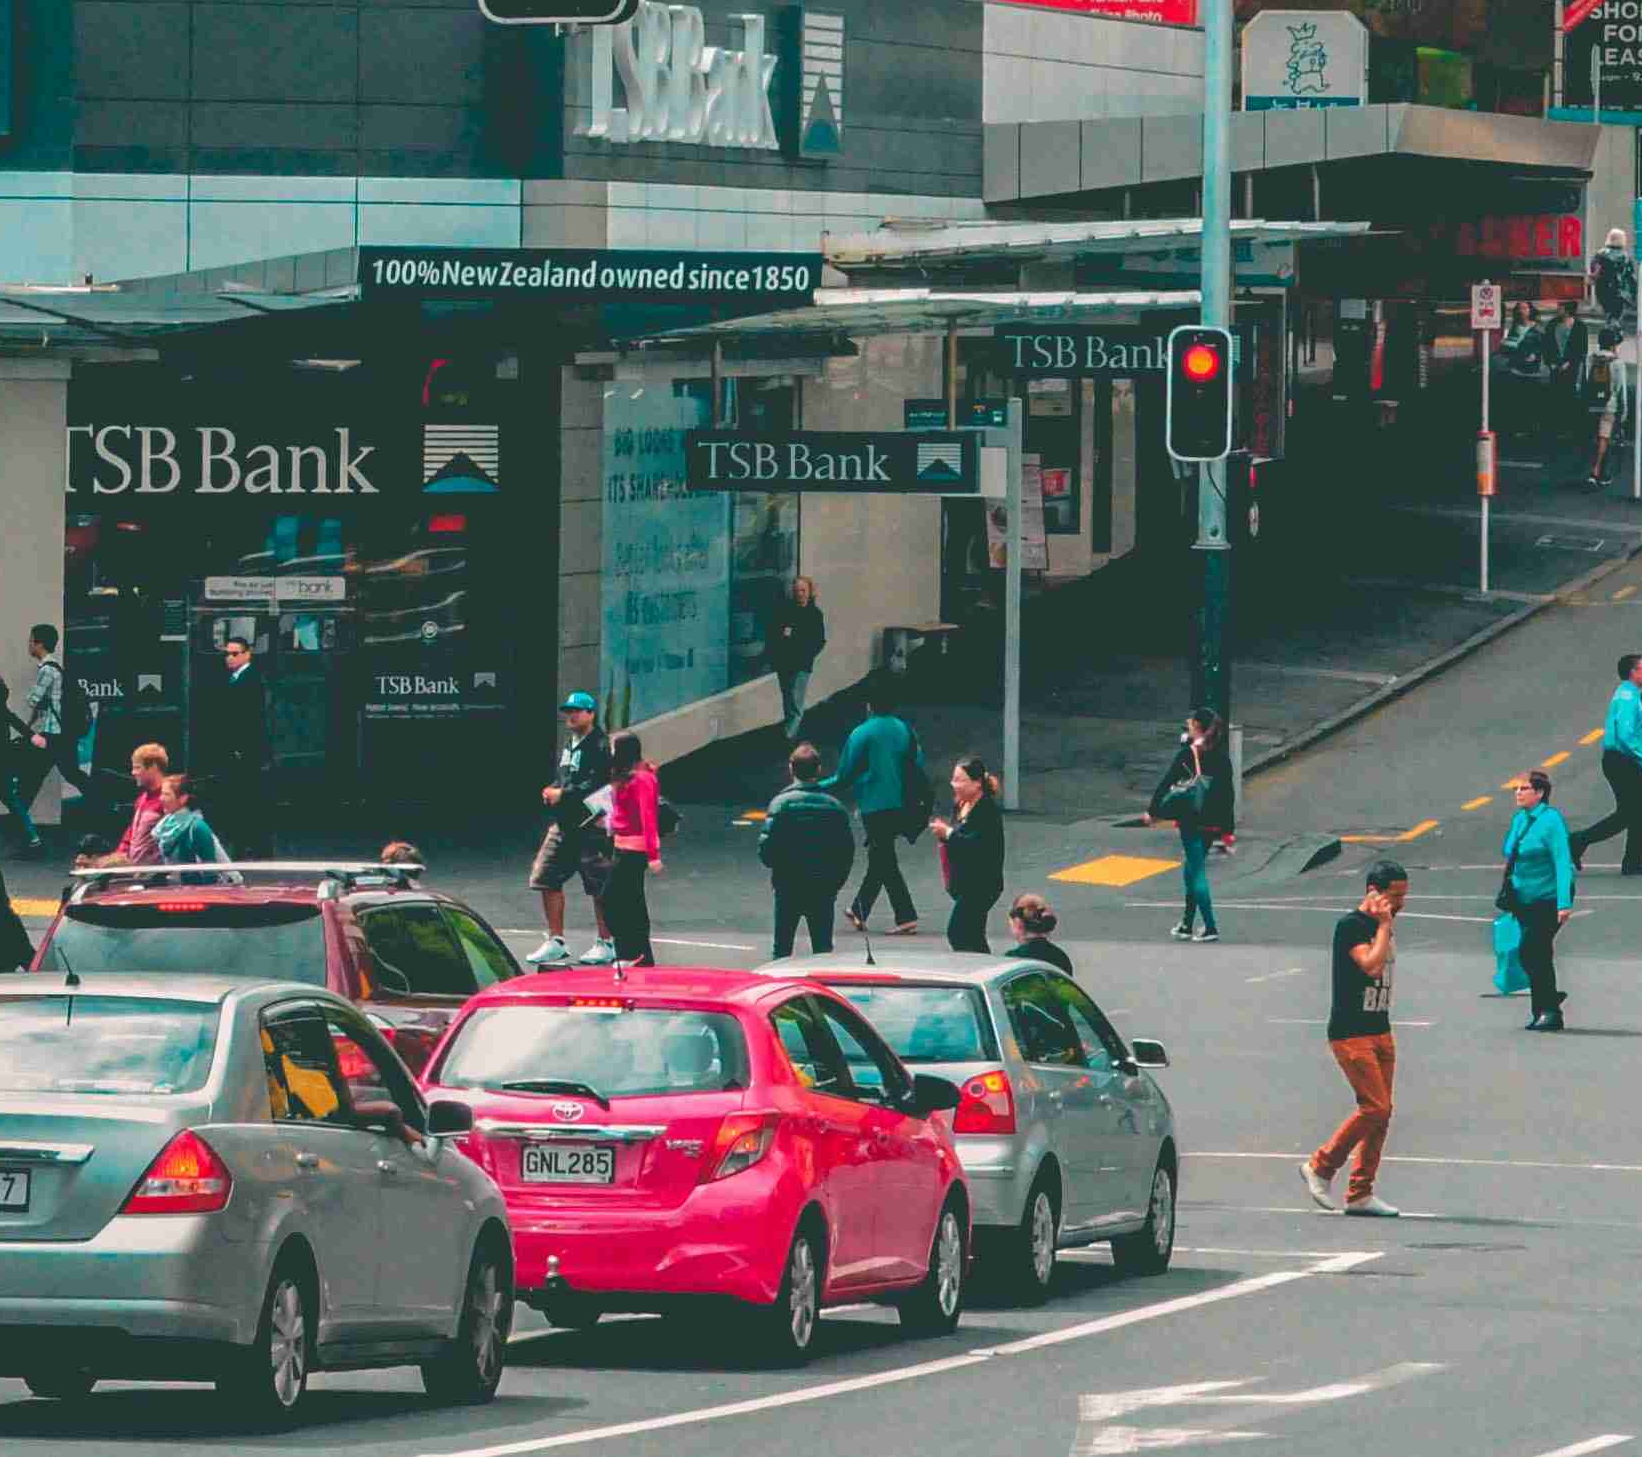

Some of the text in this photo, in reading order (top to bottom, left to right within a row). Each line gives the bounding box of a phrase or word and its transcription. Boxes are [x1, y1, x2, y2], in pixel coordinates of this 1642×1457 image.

[372, 259, 810, 292] 100% New Zealand owned since 1850
[1005, 335, 1170, 369] TSB Bank
[64, 424, 380, 494] TSB Bank
[698, 442, 782, 480] TSB
[788, 442, 891, 481] Bank
[375, 675, 461, 695] TSB Bank
[525, 1151, 609, 1175] GNL285
